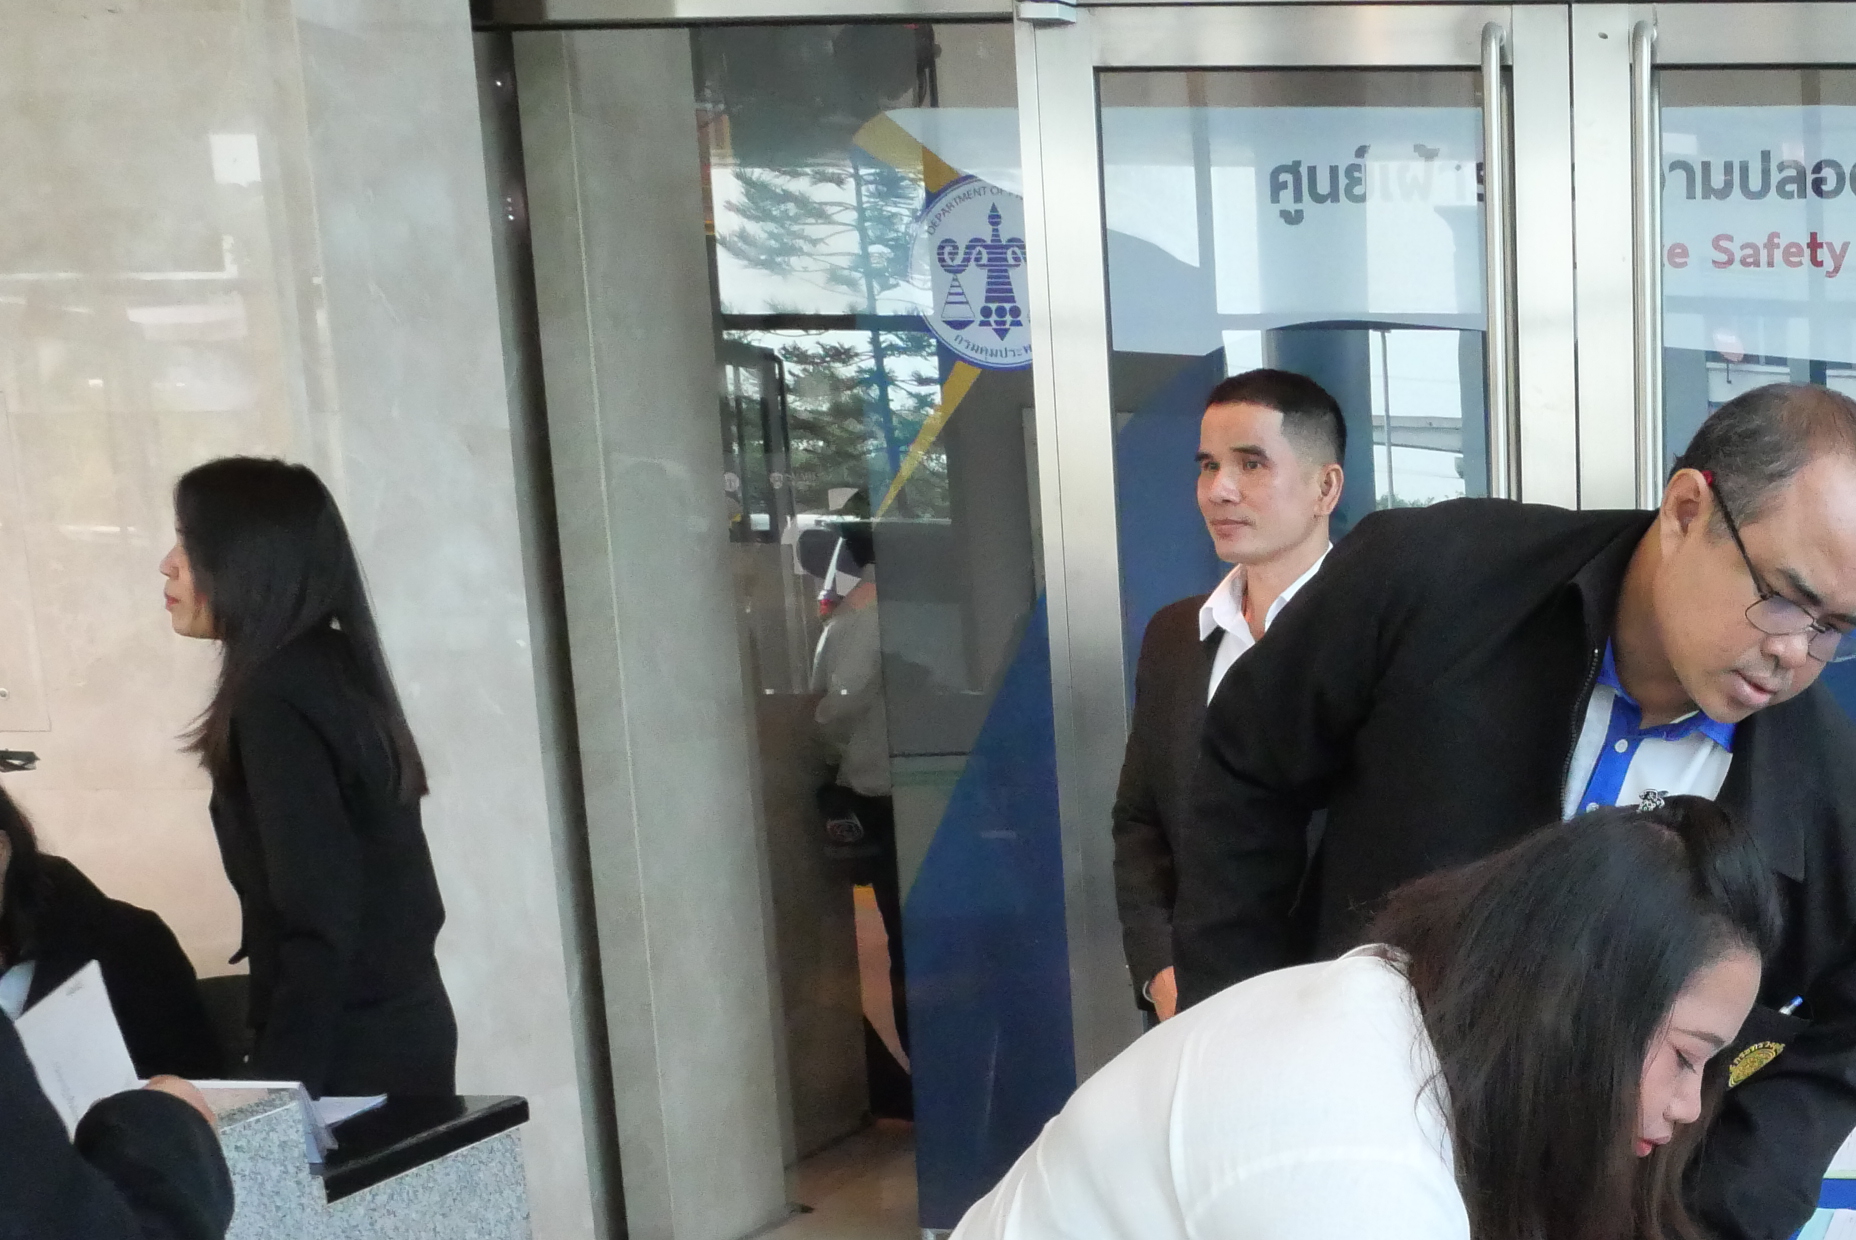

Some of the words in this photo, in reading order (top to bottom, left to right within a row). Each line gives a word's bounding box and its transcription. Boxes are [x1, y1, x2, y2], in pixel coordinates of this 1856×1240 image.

[926, 186, 988, 236] DEPARTMENT
[1710, 231, 1851, 279] Safety
[954, 334, 1033, 361] กรมคุมประพ
